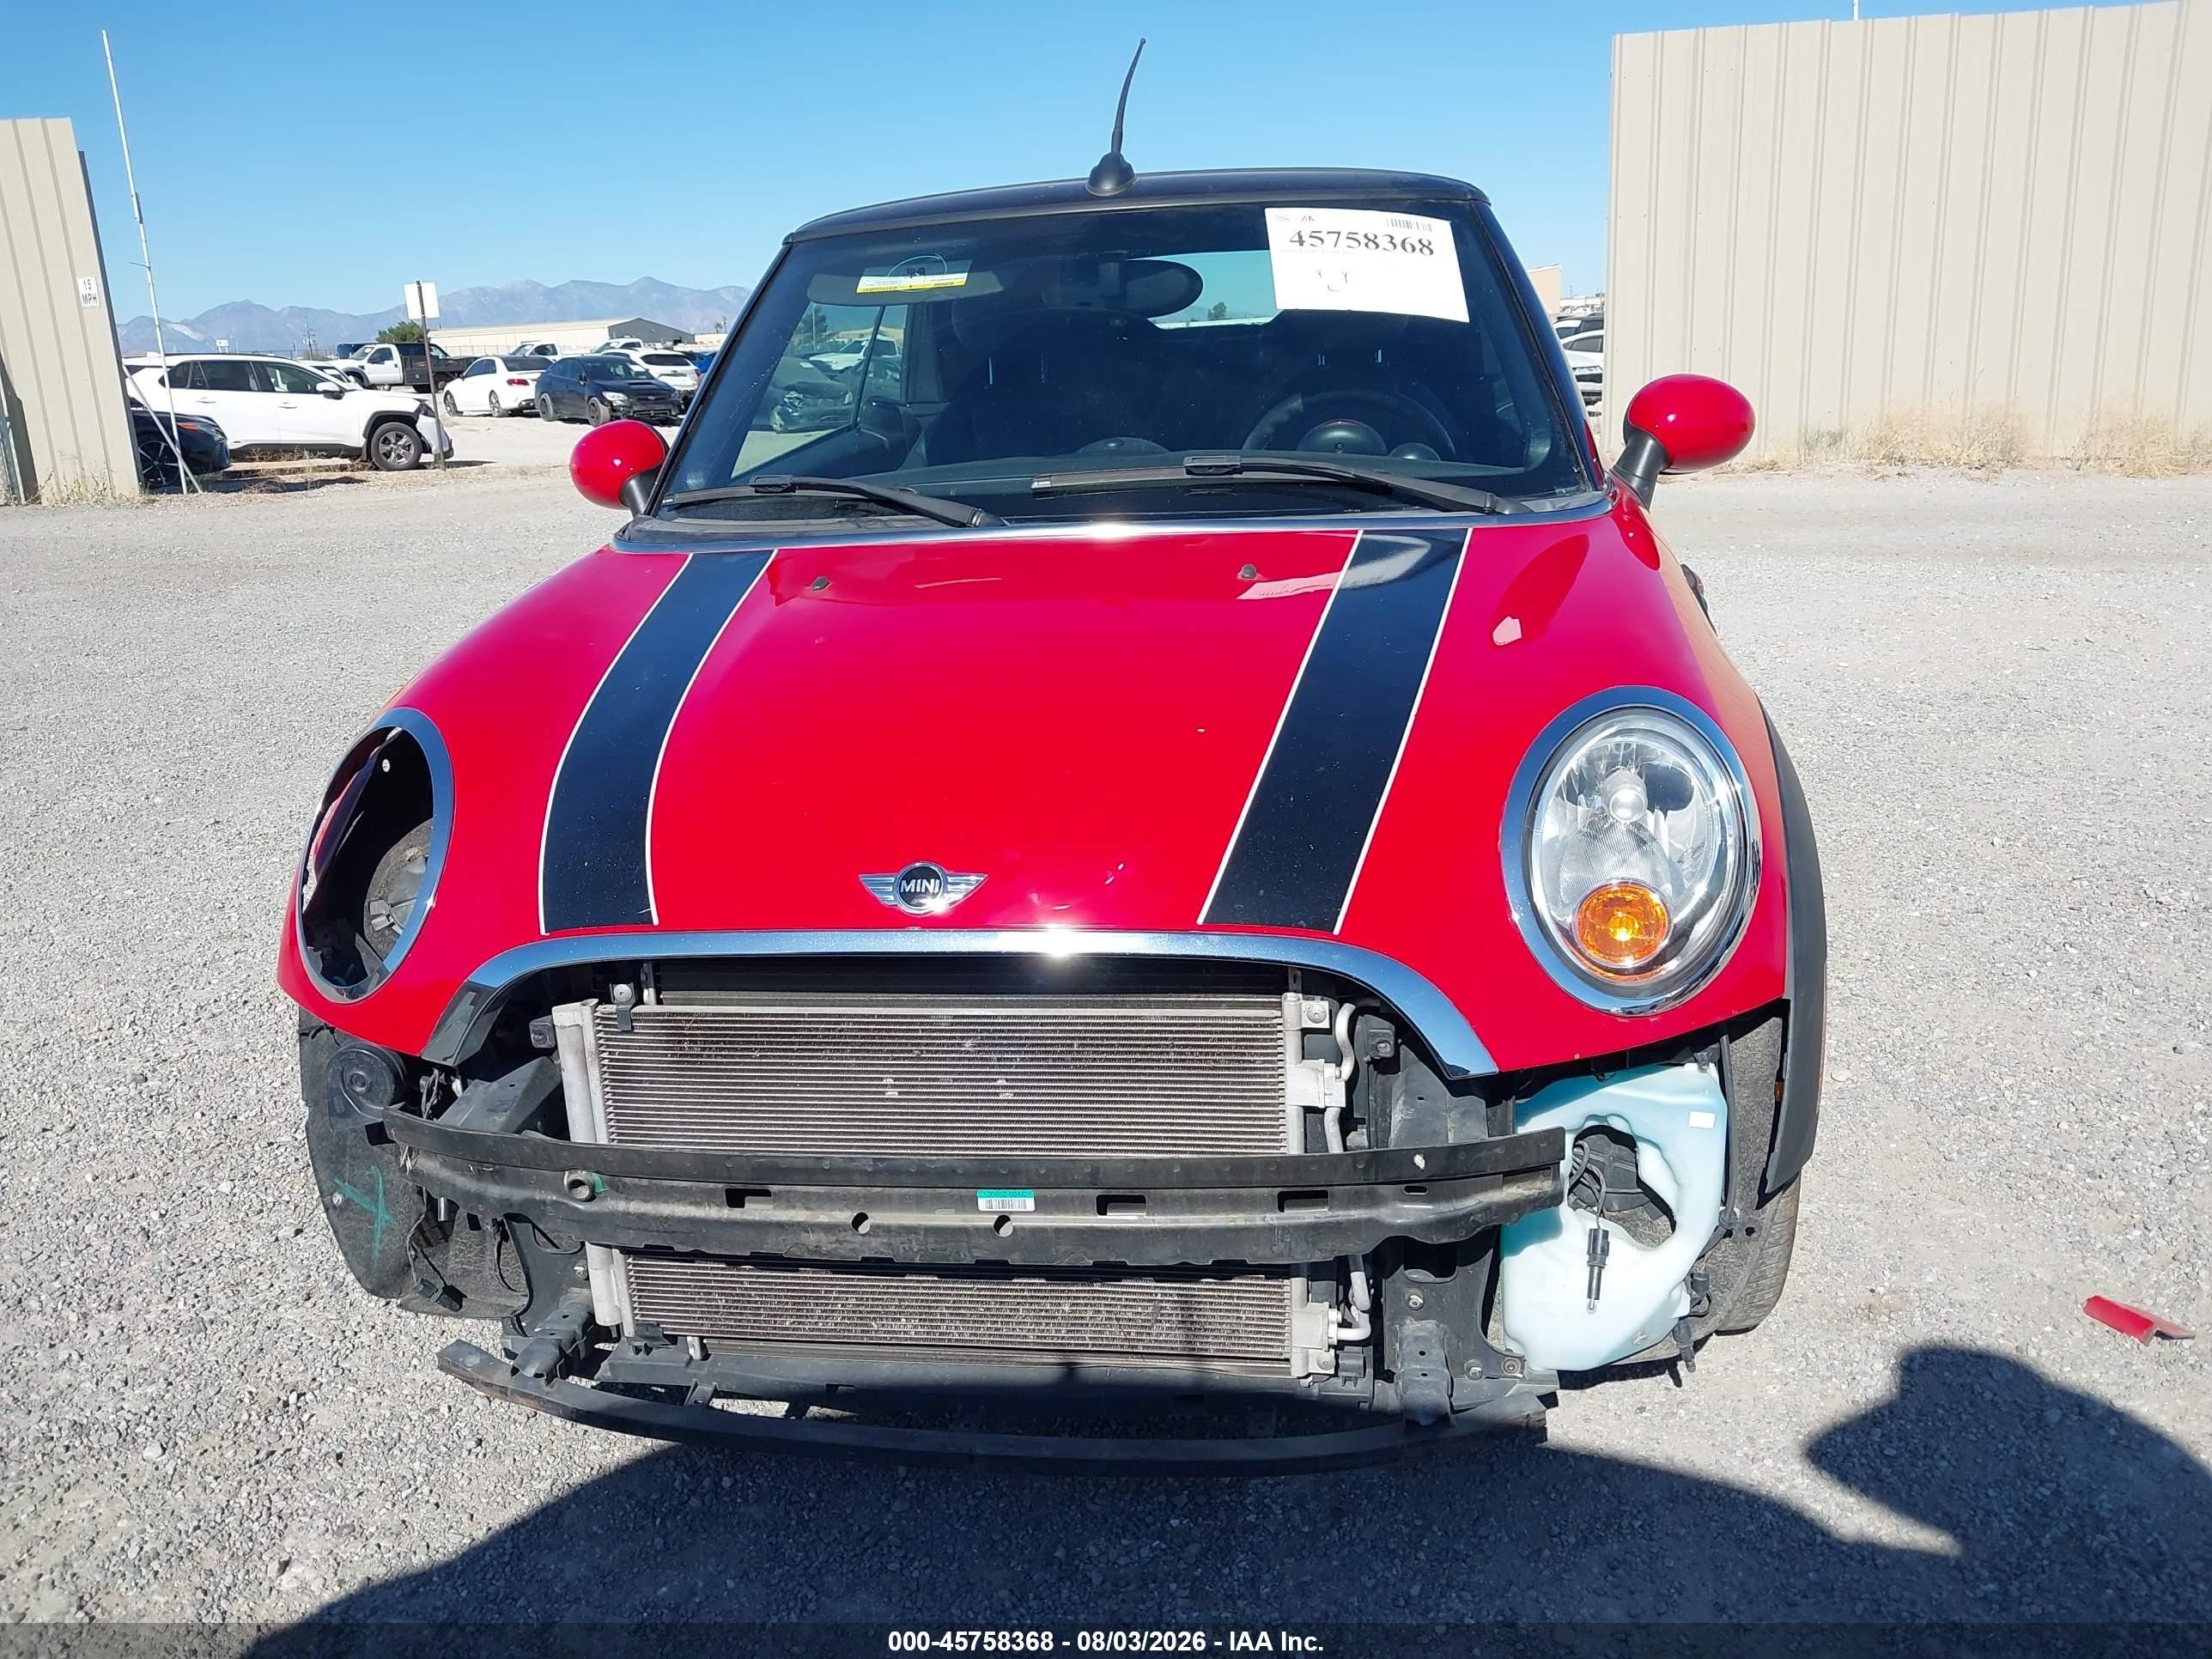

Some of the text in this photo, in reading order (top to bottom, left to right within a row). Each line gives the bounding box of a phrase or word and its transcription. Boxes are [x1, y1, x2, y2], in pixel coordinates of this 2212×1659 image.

[1289, 230, 1435, 257] 45758368
[83, 279, 92, 290] 15
[82, 294, 97, 304] MPH
[901, 878, 940, 894] MINI
